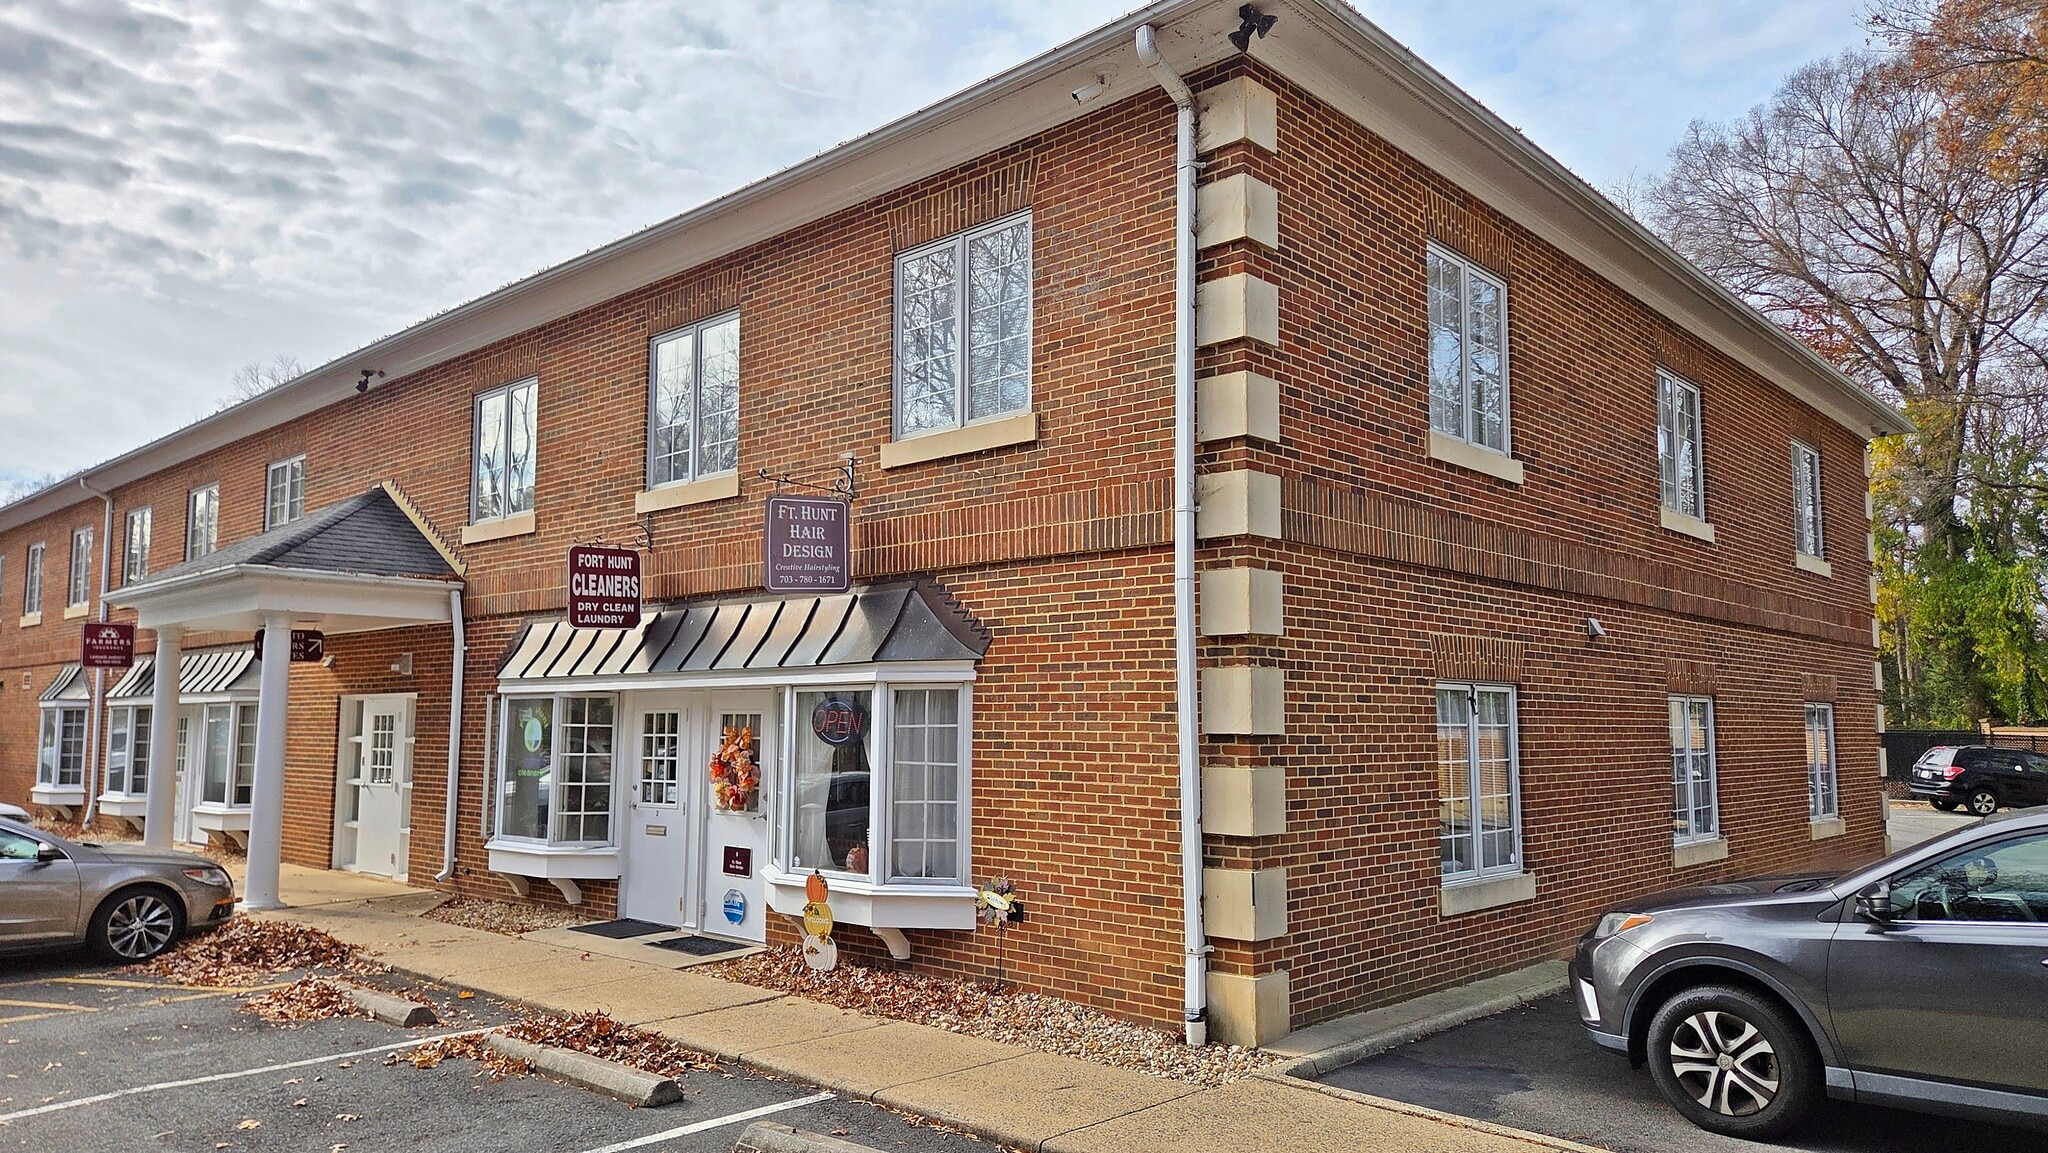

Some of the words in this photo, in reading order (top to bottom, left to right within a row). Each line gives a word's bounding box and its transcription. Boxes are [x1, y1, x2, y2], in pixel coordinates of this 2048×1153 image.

[778, 505, 798, 520] FT.
[801, 506, 838, 521] HUNT
[790, 525, 827, 540] HAIR
[783, 543, 834, 559] DESIGN
[578, 553, 604, 568] FORT
[608, 555, 633, 570] HUNT
[775, 563, 803, 571] Creative
[804, 563, 841, 574] Hairstyling
[572, 573, 639, 598] CLEANERS
[578, 602, 599, 611] DRY
[603, 603, 635, 612] CLEAN
[578, 614, 624, 624] LAUNDRY
[86, 637, 131, 646] FARMERS
[814, 709, 863, 735] OPEN
